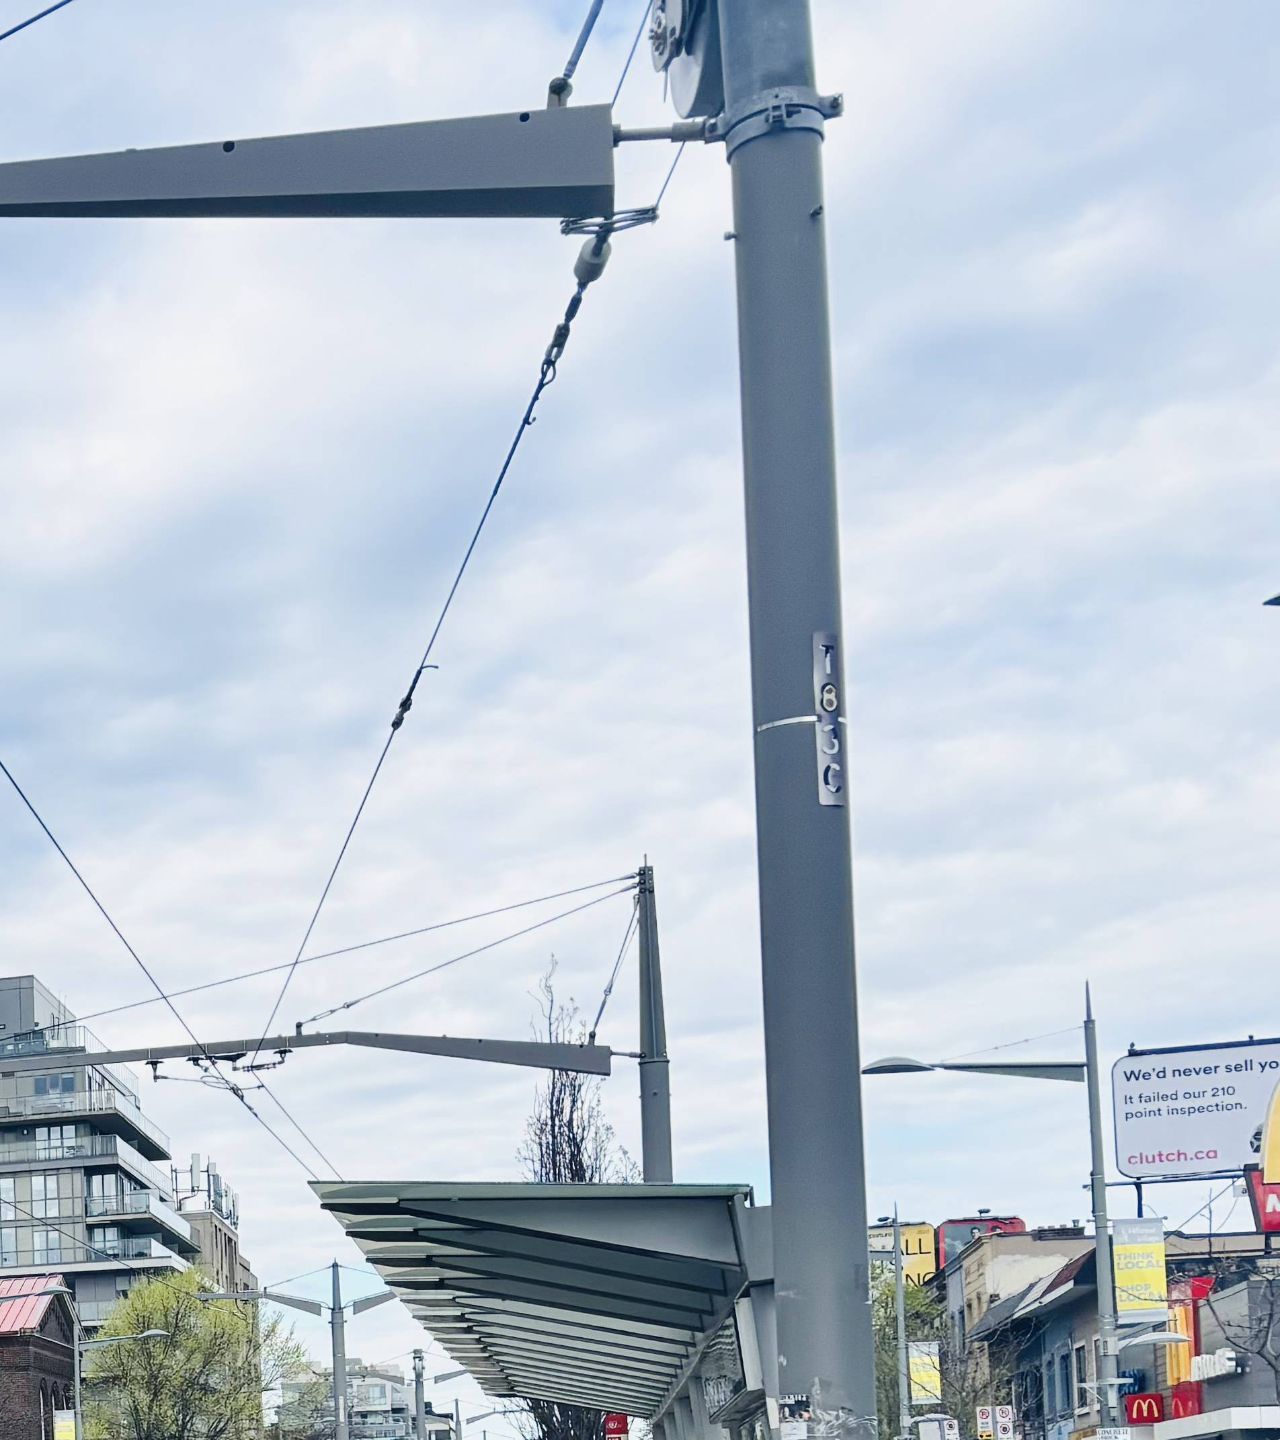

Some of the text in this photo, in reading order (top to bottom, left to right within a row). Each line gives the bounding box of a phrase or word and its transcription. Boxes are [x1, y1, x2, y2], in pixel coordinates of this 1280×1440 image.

[1124, 1067, 1167, 1082] We'd
[1172, 1065, 1220, 1078] never
[1225, 1059, 1253, 1073] sell
[1124, 1086, 1236, 1105] It failed our 210
[1125, 1102, 1248, 1121] point inspection.
[1127, 1150, 1218, 1165] clutch.ca
